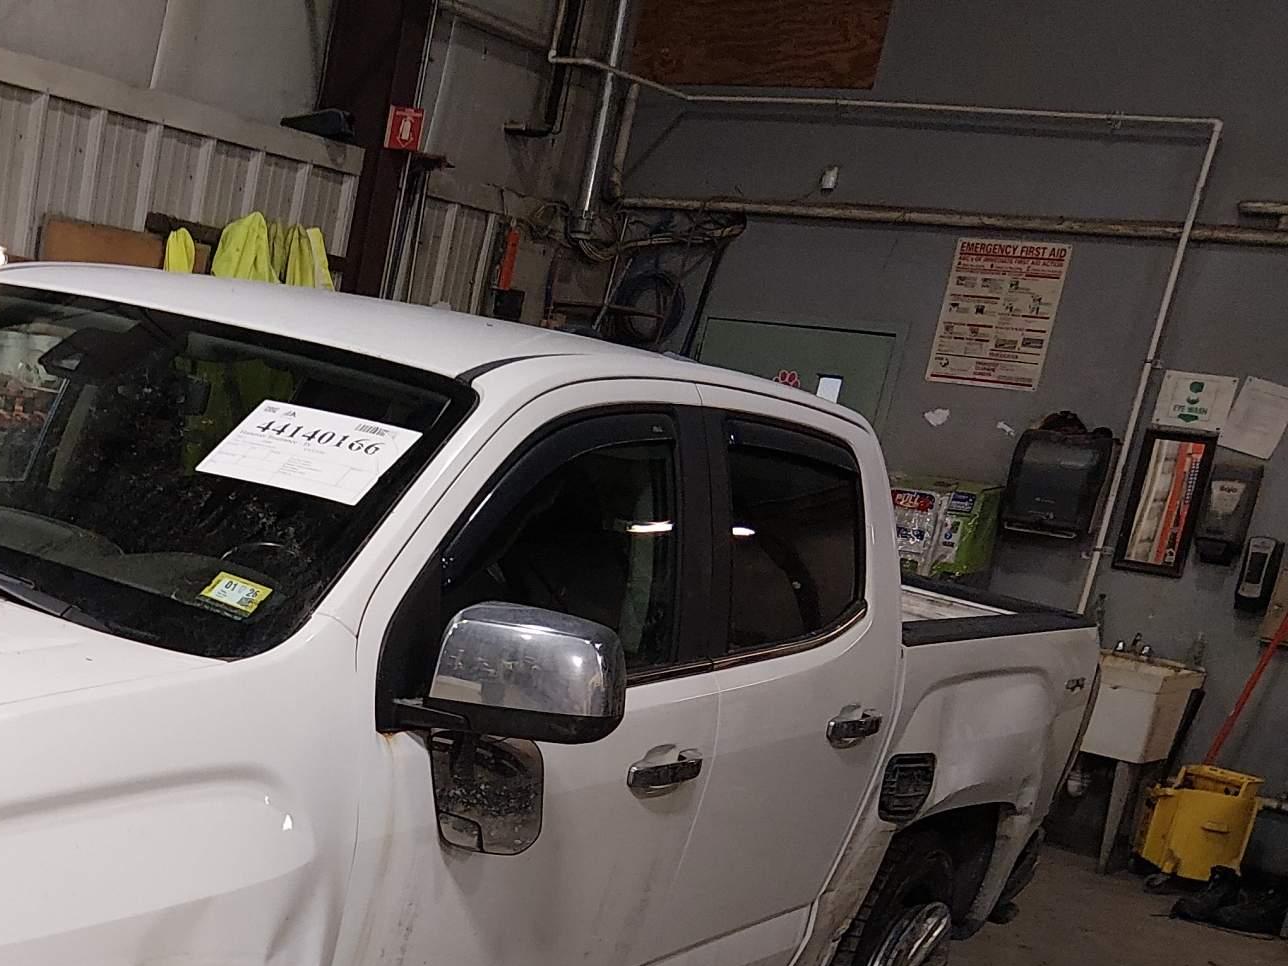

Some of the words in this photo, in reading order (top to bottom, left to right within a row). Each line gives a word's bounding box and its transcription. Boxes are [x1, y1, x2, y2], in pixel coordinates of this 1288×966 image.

[960, 241, 1018, 255] EMERGENCY
[1020, 245, 1048, 257] FIRST
[1048, 247, 1067, 258] AID
[256, 420, 385, 456] 44140166
[895, 493, 920, 506] PULL
[224, 580, 238, 592] 01
[245, 588, 260, 598] 26
